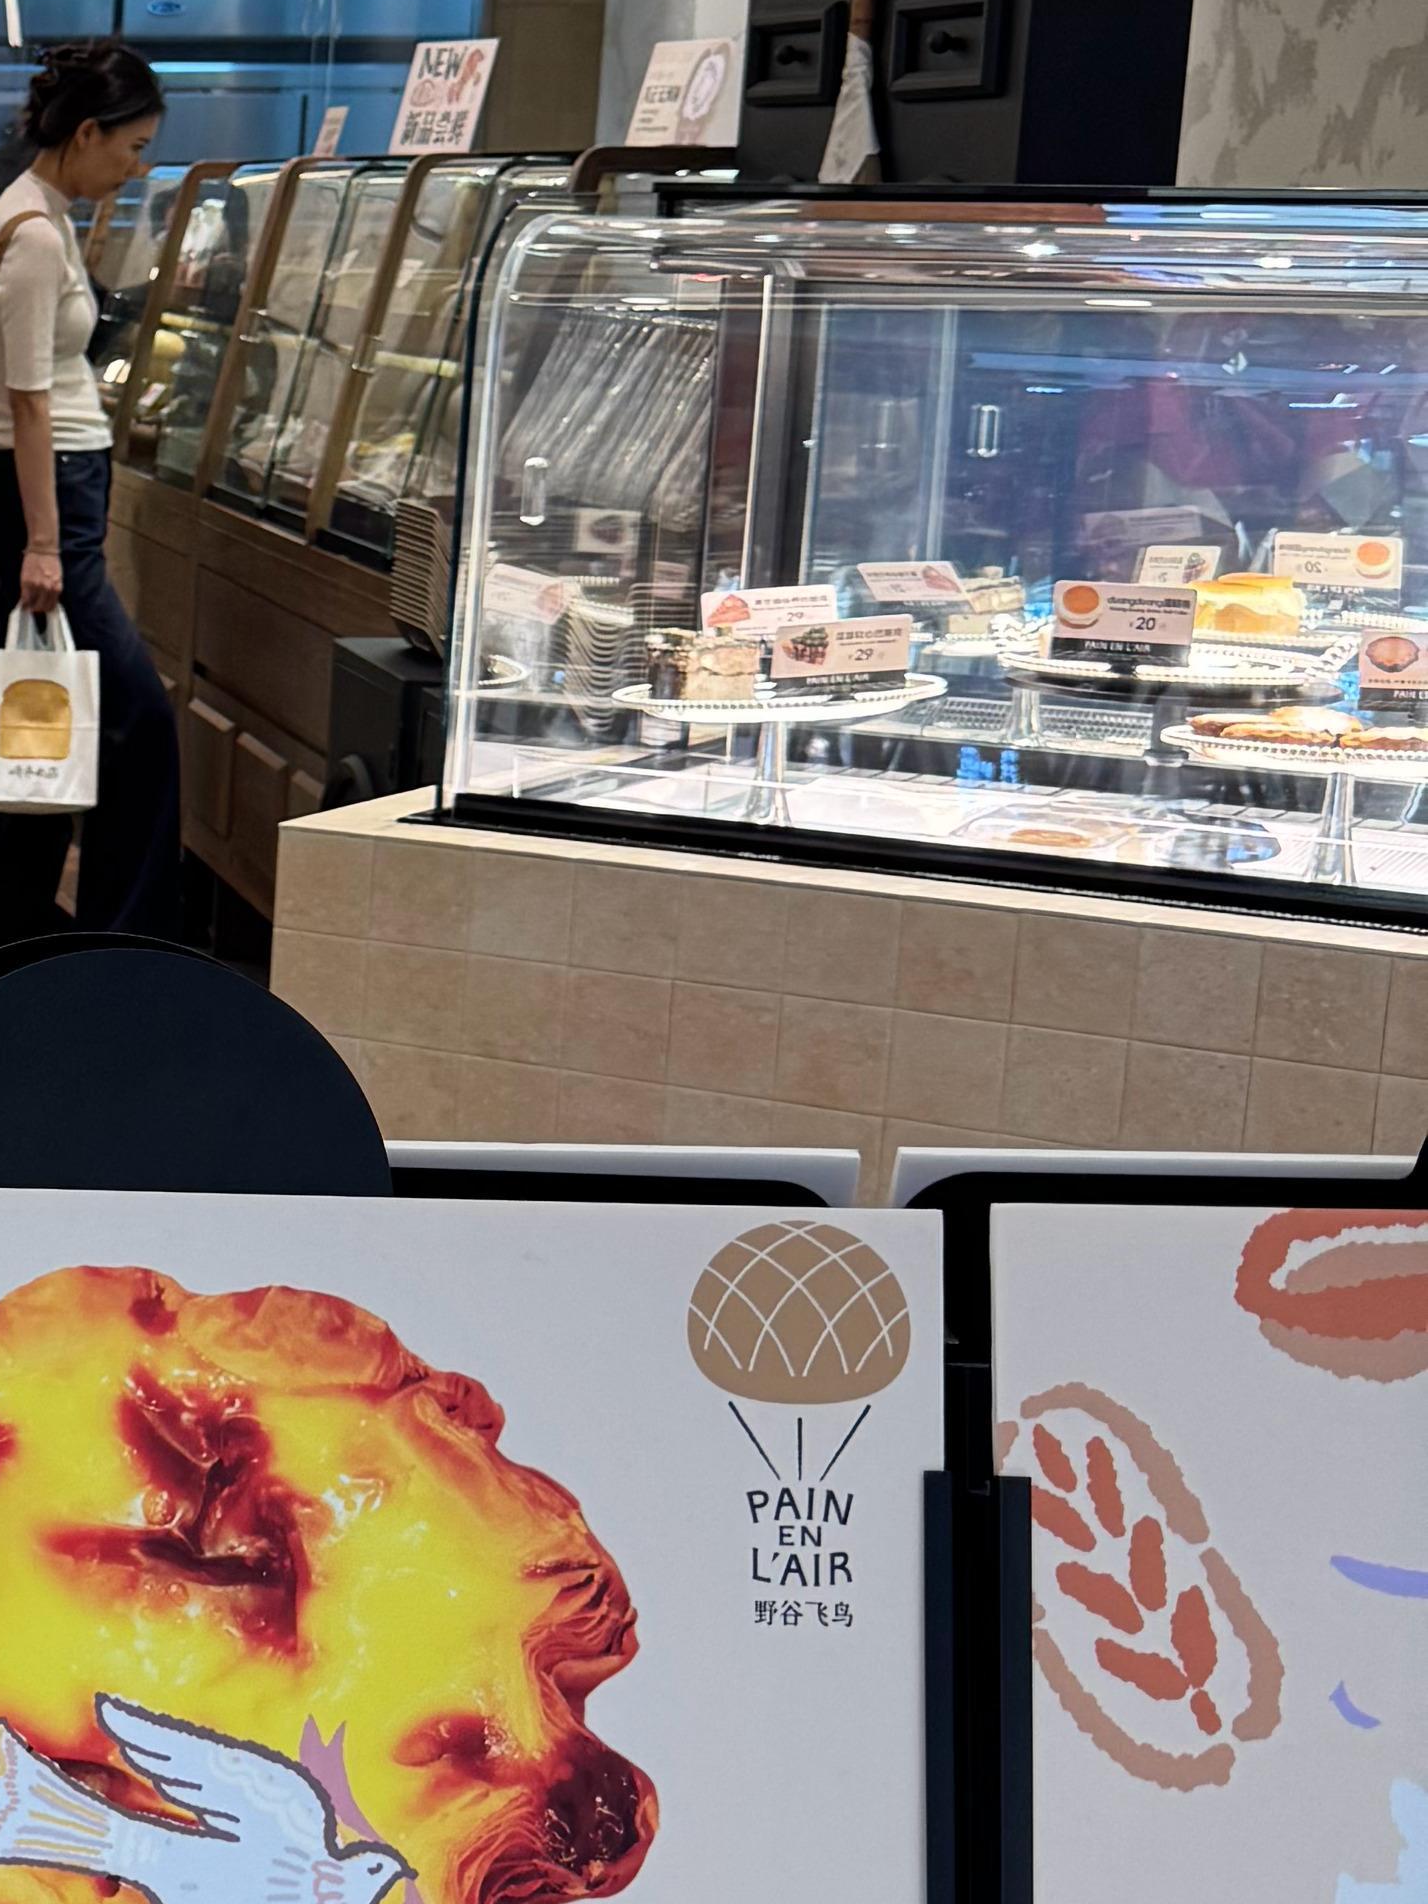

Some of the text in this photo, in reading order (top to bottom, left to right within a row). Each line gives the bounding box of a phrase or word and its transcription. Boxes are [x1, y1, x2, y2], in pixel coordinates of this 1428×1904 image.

[418, 46, 467, 80] NEW
[746, 1486, 854, 1526] PAIN
[777, 1525, 823, 1547] EN
[751, 1547, 853, 1588] L'AIR
[753, 1599, 854, 1627] 野谷飞鸟
